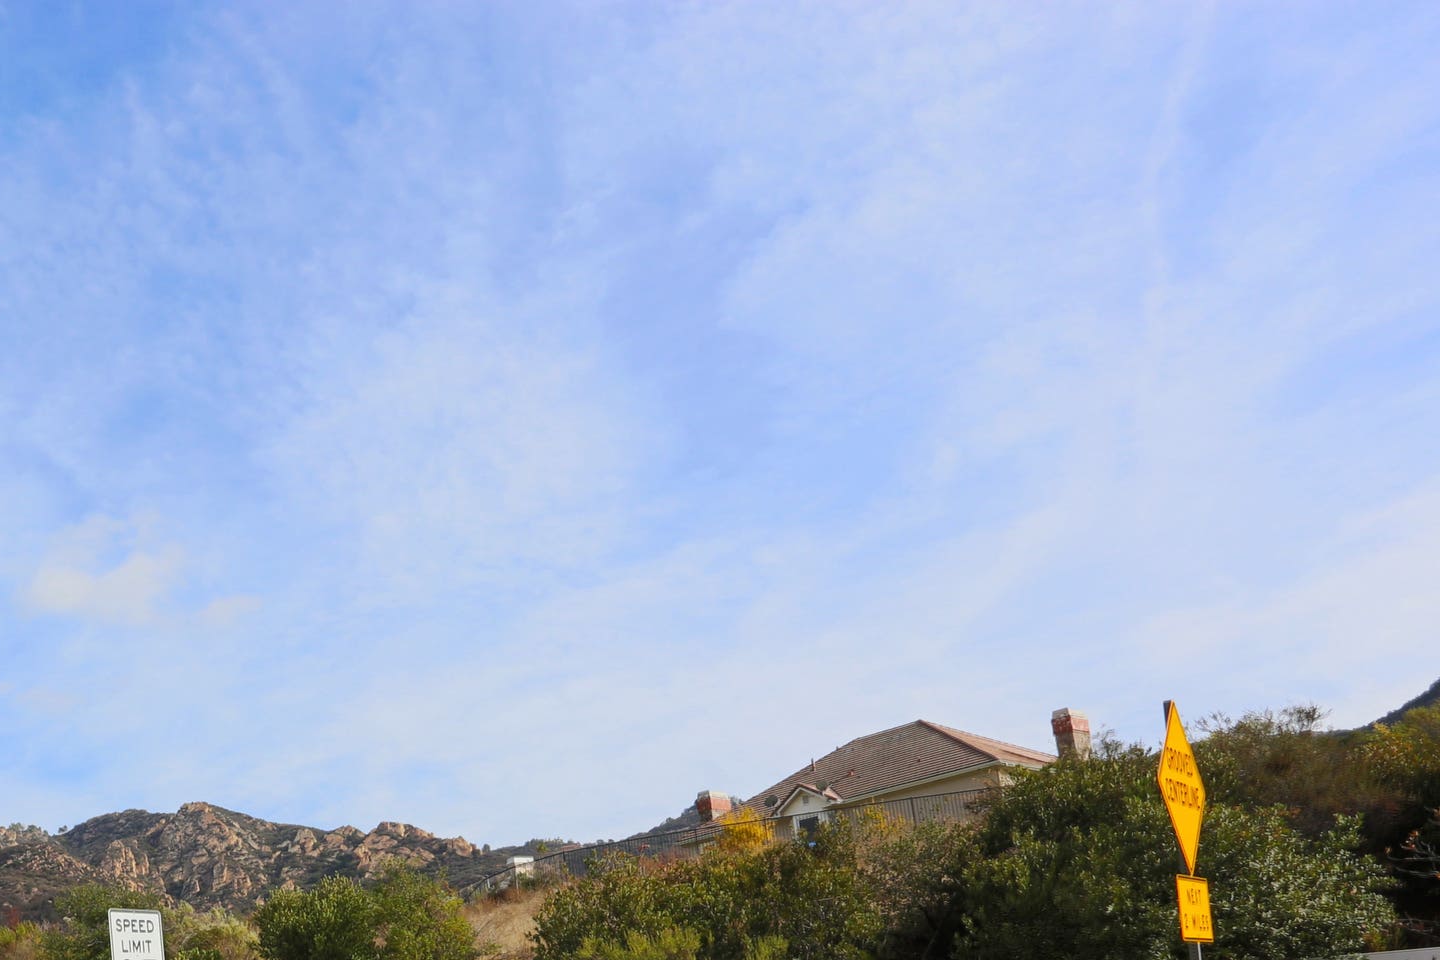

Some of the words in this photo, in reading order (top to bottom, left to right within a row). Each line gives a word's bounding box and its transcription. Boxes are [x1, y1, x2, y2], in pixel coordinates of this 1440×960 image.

[1166, 746, 1193, 777] GROOVED
[1165, 778, 1201, 810] CENTERLINE
[1187, 887, 1201, 904] NEXT
[115, 918, 155, 933] SPEED
[1192, 914, 1210, 930] MILES
[121, 940, 152, 953] LIMIT
